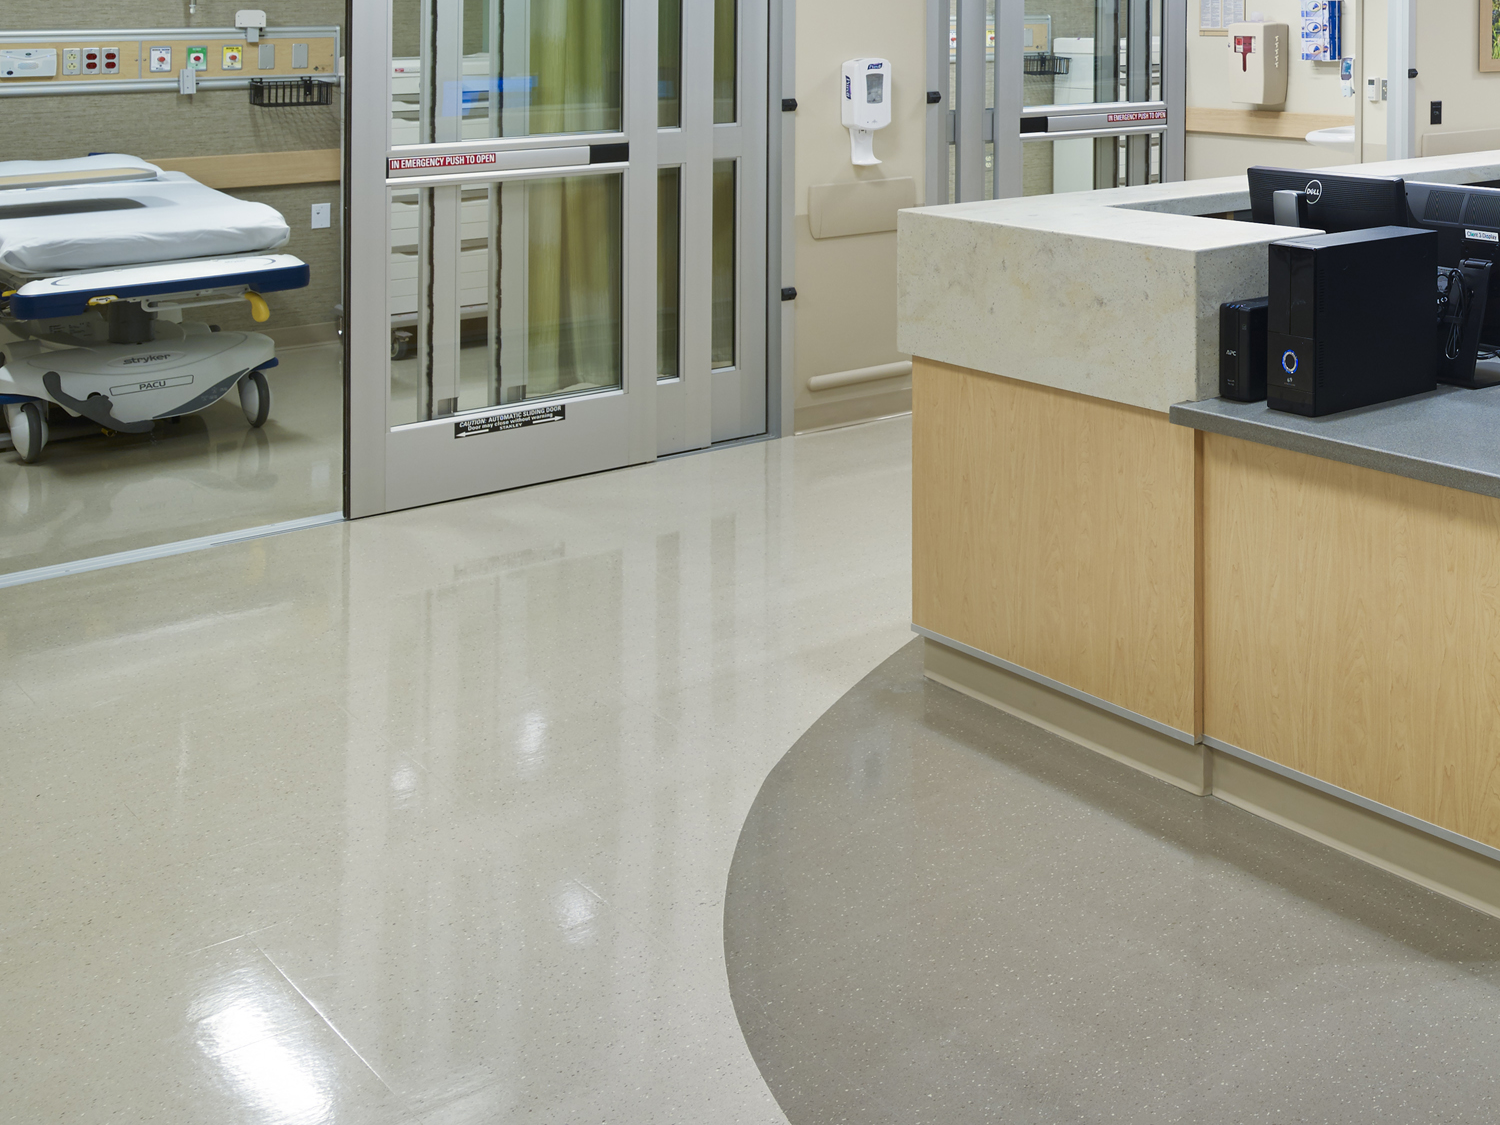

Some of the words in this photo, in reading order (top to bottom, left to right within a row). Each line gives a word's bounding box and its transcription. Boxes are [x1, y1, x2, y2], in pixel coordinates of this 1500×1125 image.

[1114, 113, 1137, 121] EMERGENCY
[391, 161, 399, 169] IN
[401, 157, 444, 168] EMERGENCY
[446, 155, 465, 165] PUSH
[476, 154, 495, 163] OPEN
[1306, 188, 1320, 196] DELL
[123, 354, 171, 365] stryker
[139, 380, 166, 390] PACU
[459, 419, 486, 428] CAUTION:
[488, 413, 522, 423] AUTOMATIC
[522, 409, 545, 417] SLIDING
[545, 405, 562, 413] DOOR
